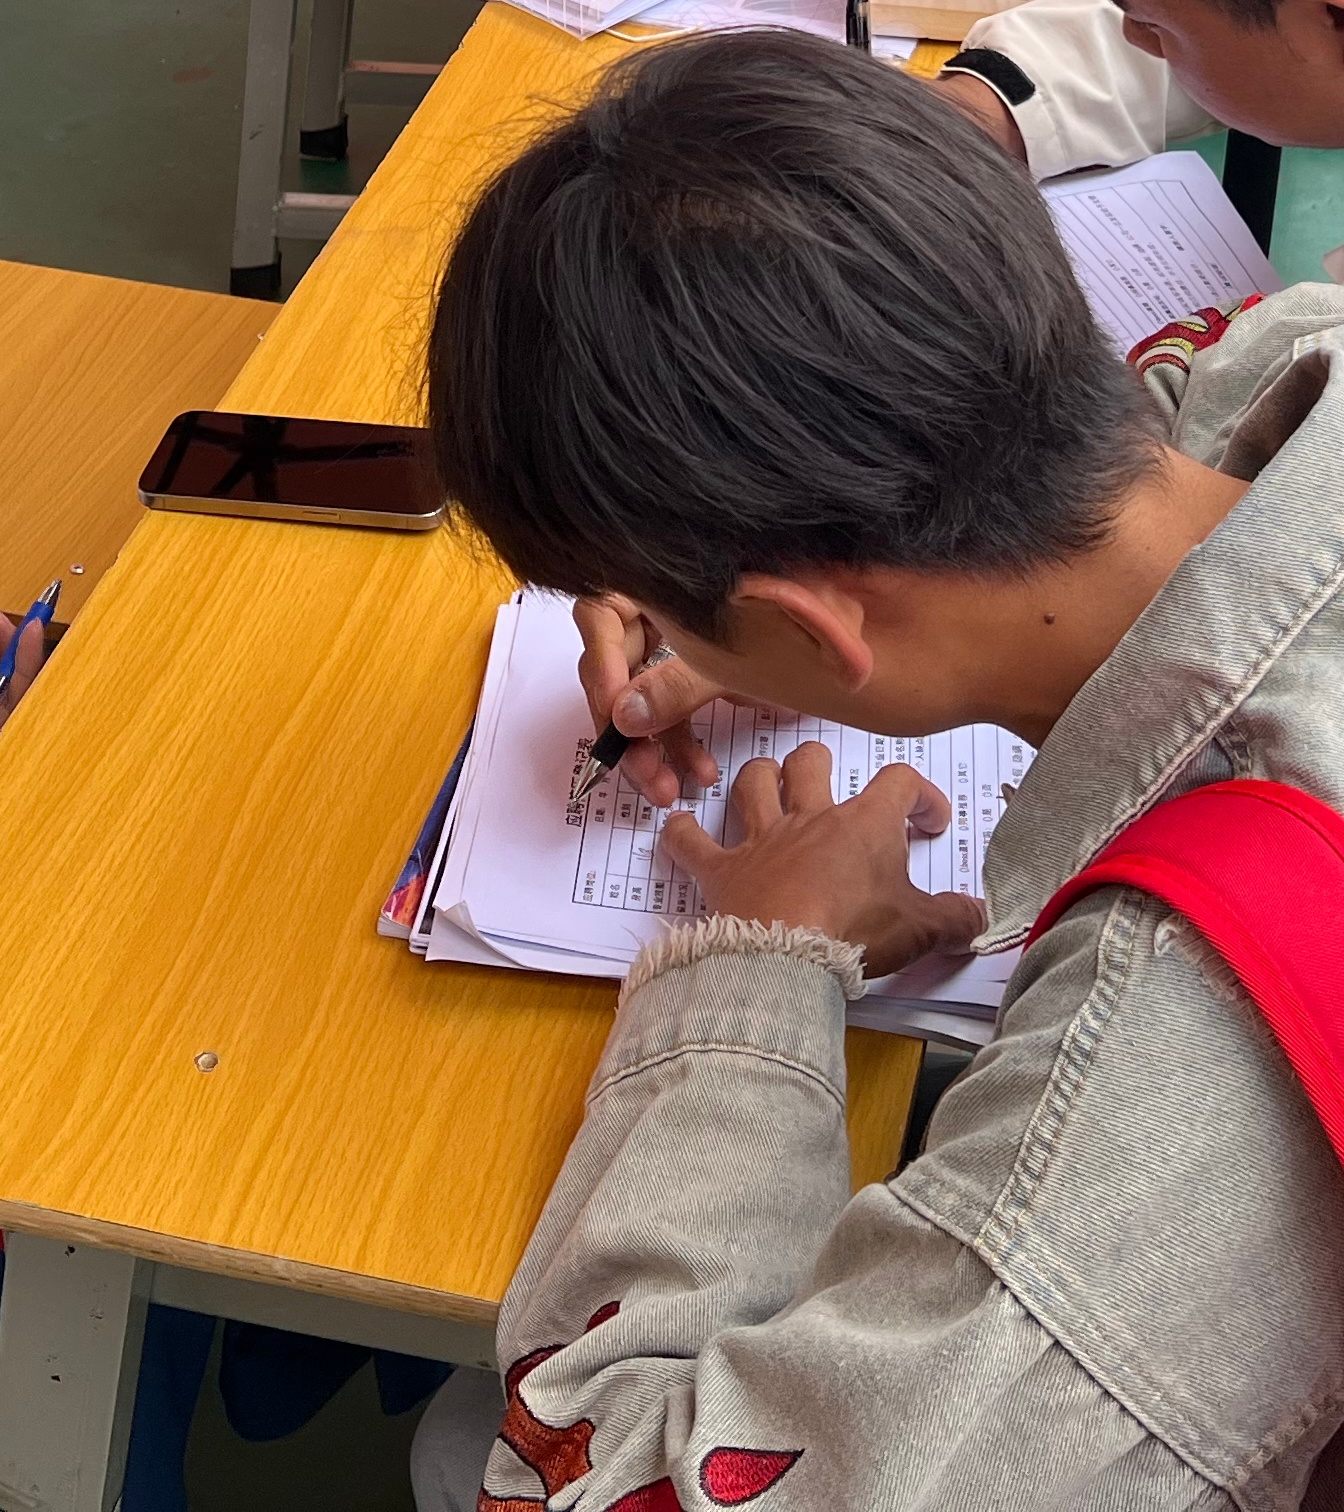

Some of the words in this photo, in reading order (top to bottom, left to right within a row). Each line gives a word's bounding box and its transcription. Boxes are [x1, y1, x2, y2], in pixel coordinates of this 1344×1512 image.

[565, 738, 594, 828] 应聘登记表
[620, 803, 632, 819] 性别
[608, 884, 621, 899] 姓名
[630, 886, 643, 902] 身高
